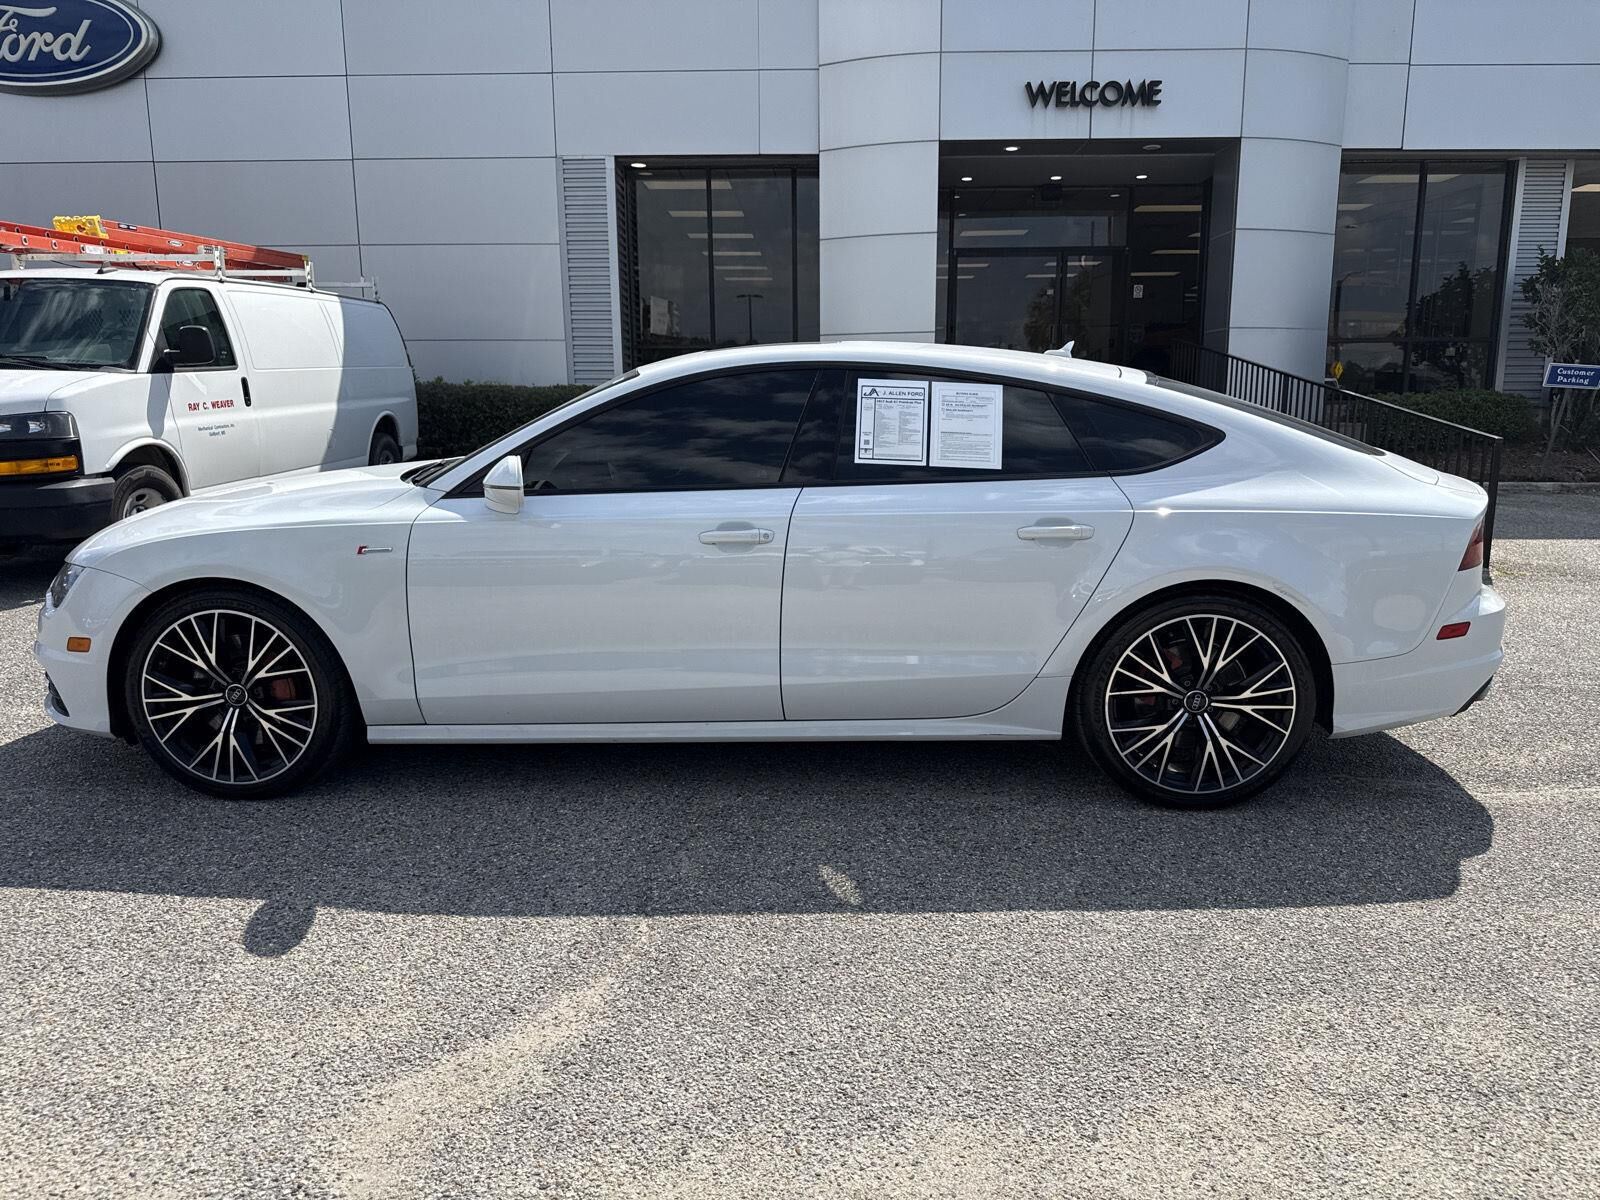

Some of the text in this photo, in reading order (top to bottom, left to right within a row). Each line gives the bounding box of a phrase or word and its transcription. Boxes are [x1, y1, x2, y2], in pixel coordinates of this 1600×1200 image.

[1024, 78, 1163, 110] WELCOME
[1557, 367, 1595, 376] Customer
[1557, 376, 1589, 385] Parking
[188, 399, 235, 412] RAY C. WEAVER
